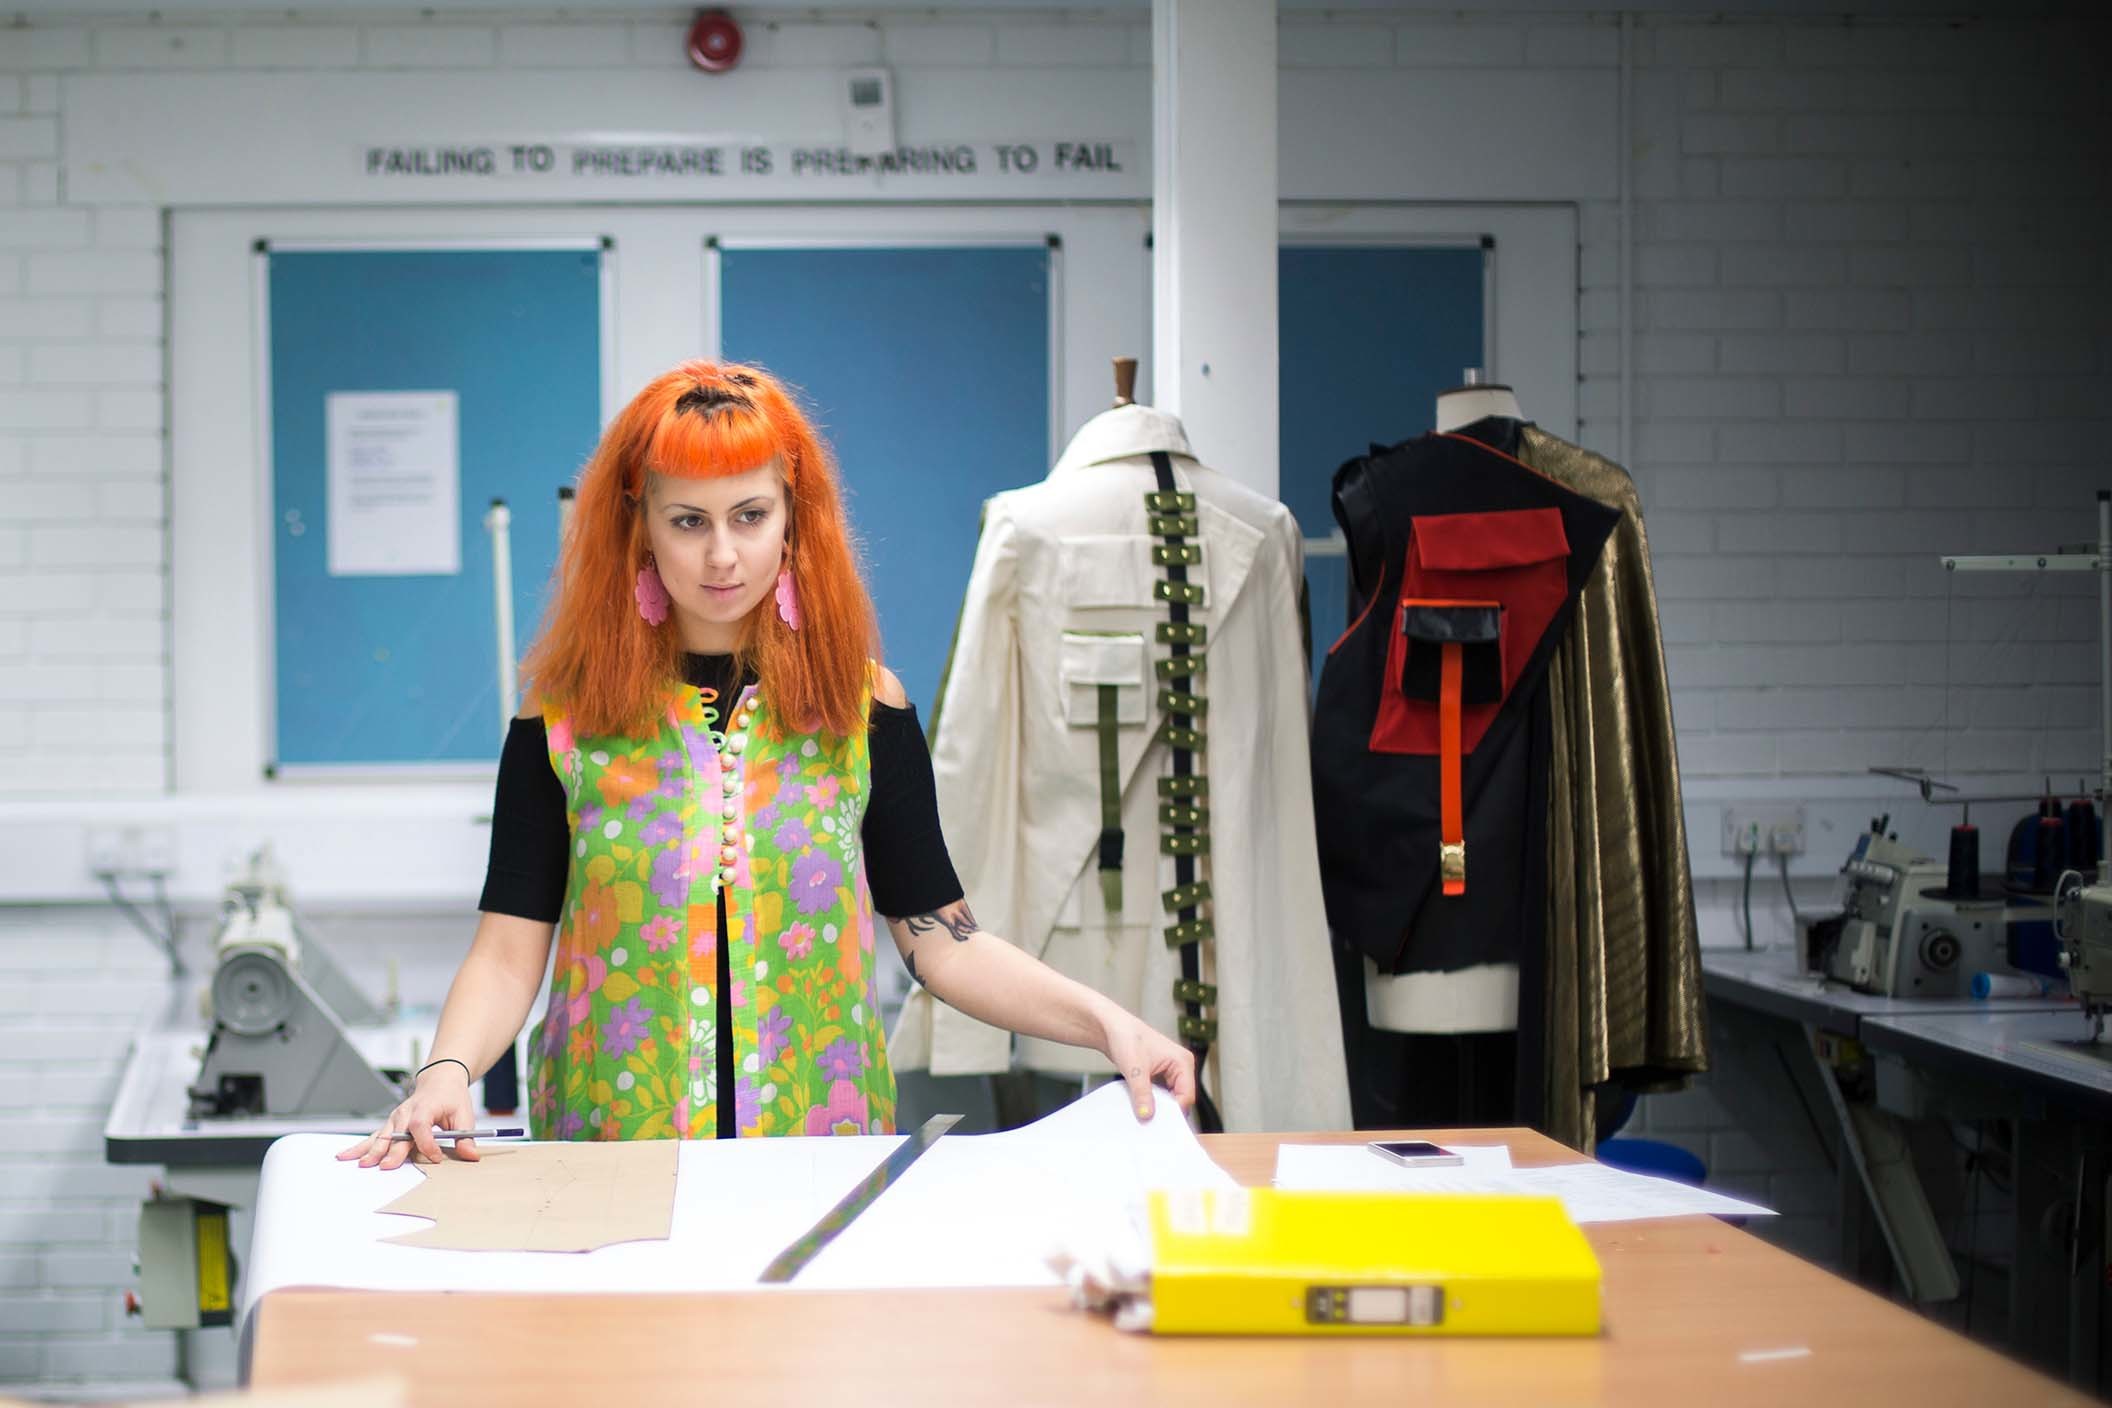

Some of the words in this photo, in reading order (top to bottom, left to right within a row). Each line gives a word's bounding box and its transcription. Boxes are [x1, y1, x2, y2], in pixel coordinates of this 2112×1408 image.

[365, 147, 495, 175] FAILING
[508, 145, 554, 172] TO
[571, 147, 723, 175] PREPARE
[740, 147, 773, 174] IS
[995, 145, 1038, 172] TO
[1054, 142, 1123, 171] FAIL
